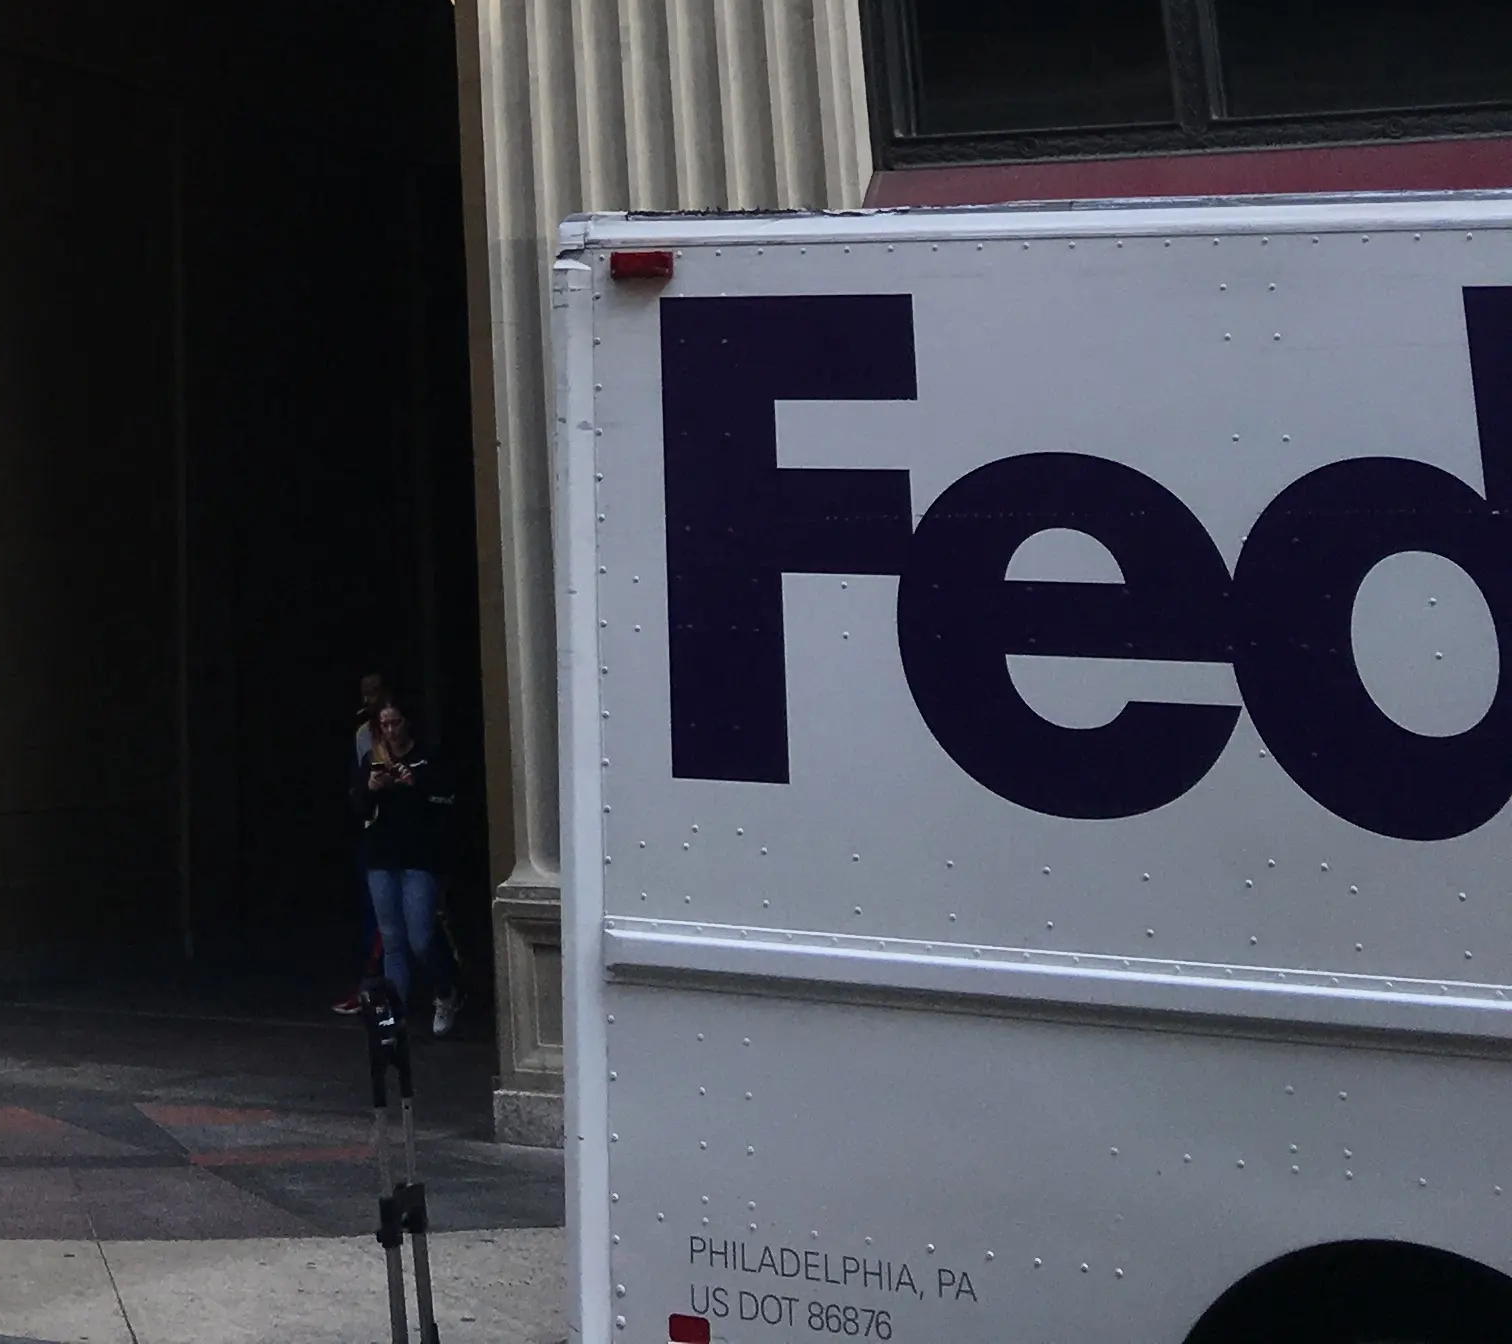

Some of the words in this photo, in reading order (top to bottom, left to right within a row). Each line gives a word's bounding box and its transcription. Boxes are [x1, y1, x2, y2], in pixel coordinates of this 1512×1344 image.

[689, 1235, 925, 1301] PHILADELPHIA,
[938, 1268, 978, 1302] PA
[690, 1284, 730, 1318] US
[739, 1291, 800, 1327] DOT
[807, 1300, 893, 1340] 86876
